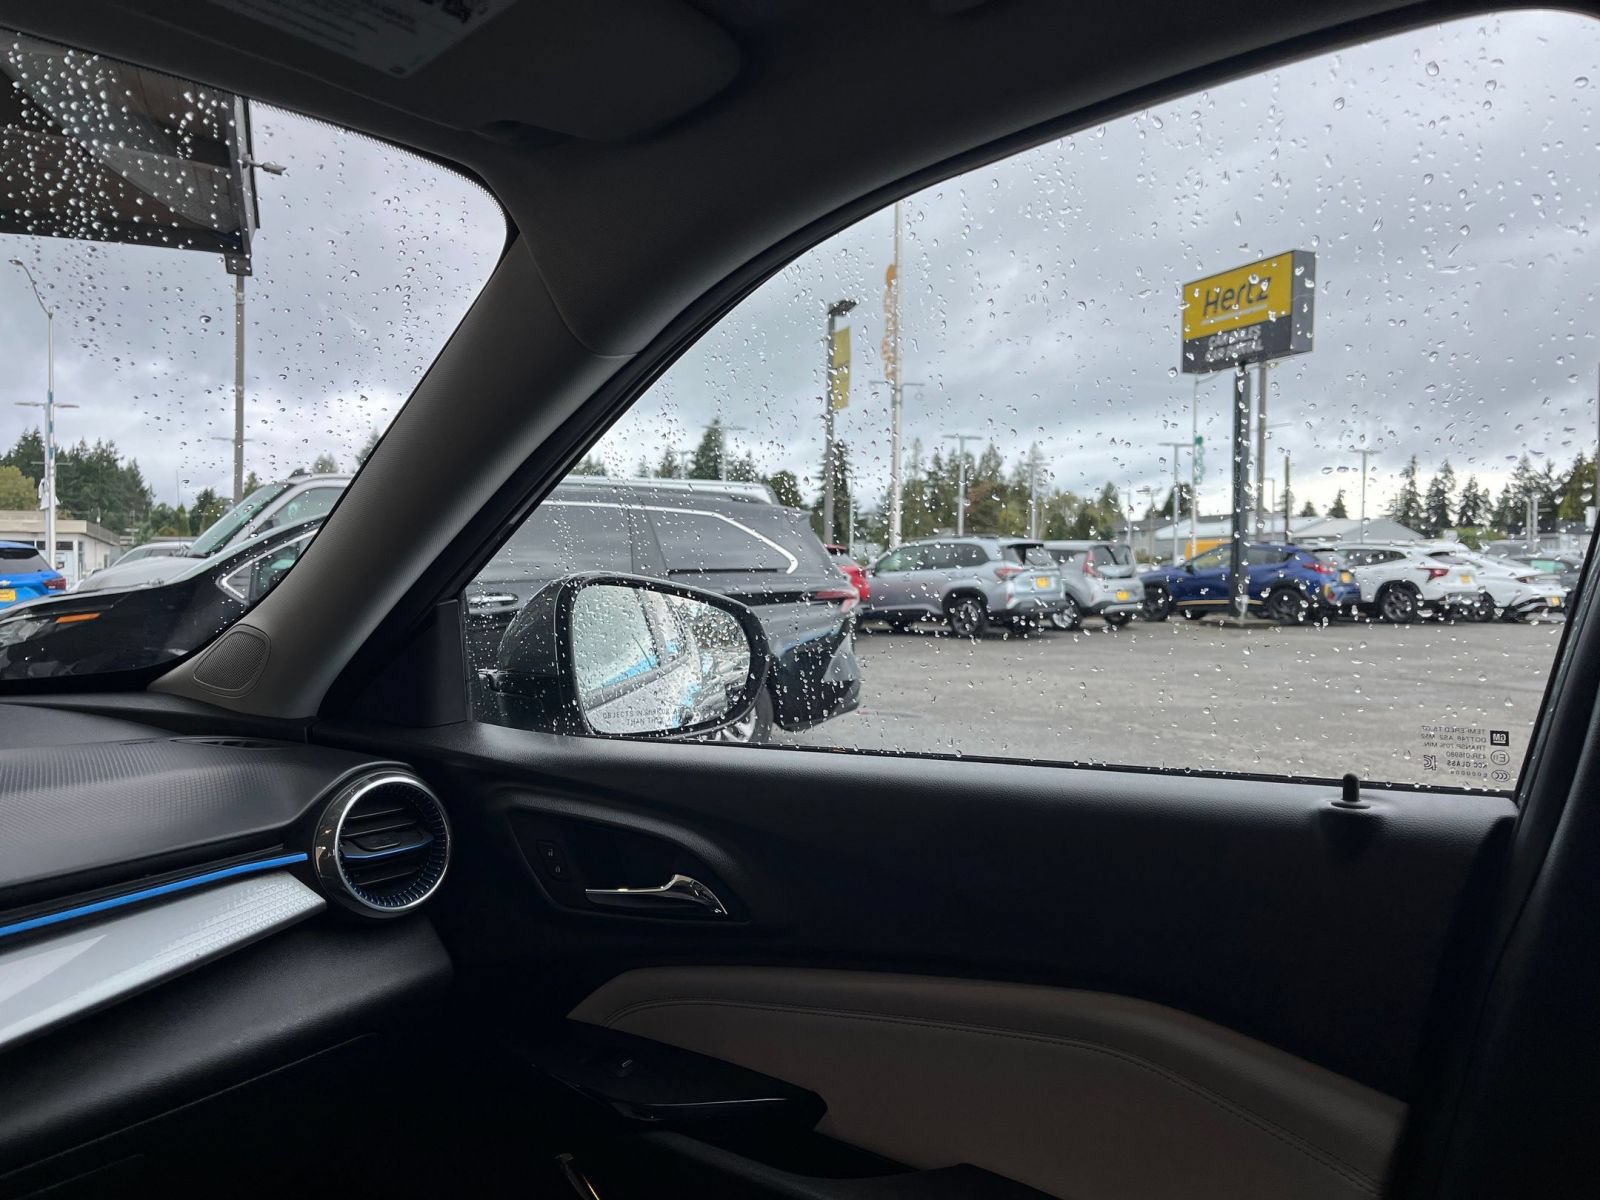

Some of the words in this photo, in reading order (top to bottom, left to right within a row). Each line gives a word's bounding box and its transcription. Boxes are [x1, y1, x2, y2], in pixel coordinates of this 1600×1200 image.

[1203, 276, 1272, 317] Hertz
[602, 711, 634, 719] OBJECTS
[626, 717, 645, 726] THAN
